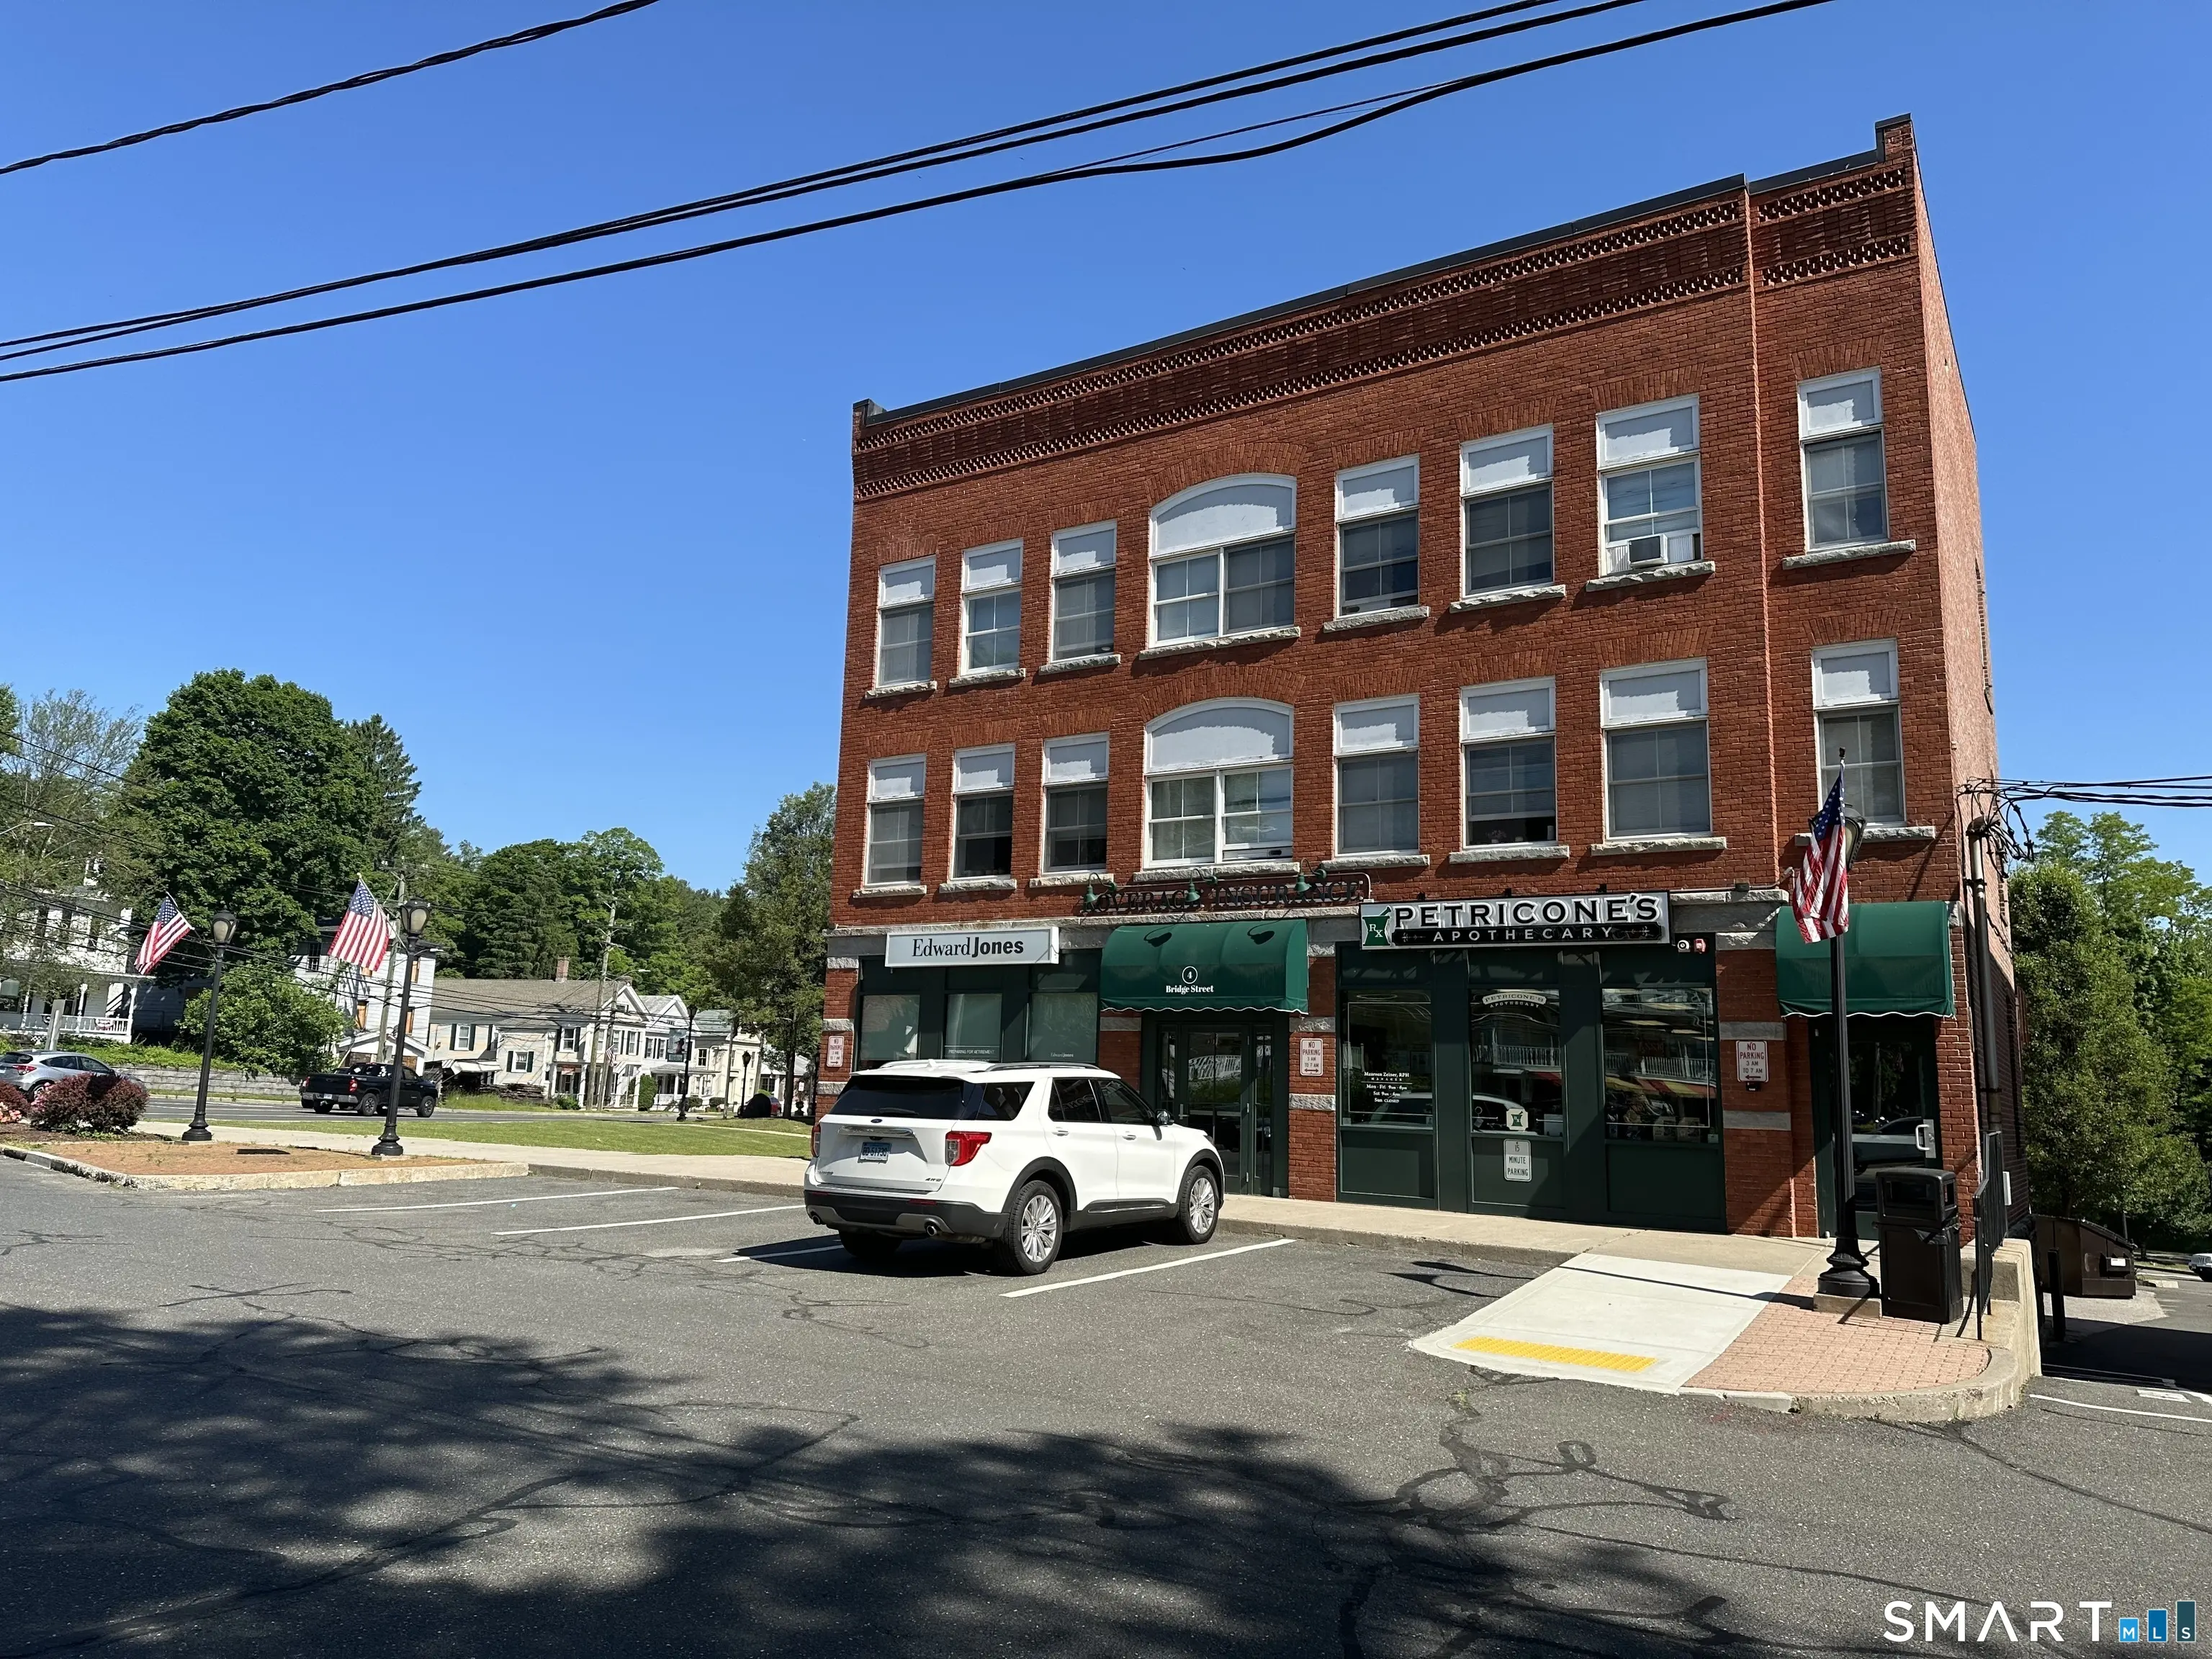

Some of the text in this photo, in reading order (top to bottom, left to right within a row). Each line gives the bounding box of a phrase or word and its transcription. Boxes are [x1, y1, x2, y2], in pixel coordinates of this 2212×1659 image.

[1395, 895, 1658, 928] PETRICONE'S
[1433, 927, 1612, 942] APOTHECARY
[1187, 971, 1193, 979] 4
[1166, 985, 1190, 994] Bridge
[1509, 1156, 1526, 1164] MINUTE
[1507, 1167, 1529, 1177] PARKING
